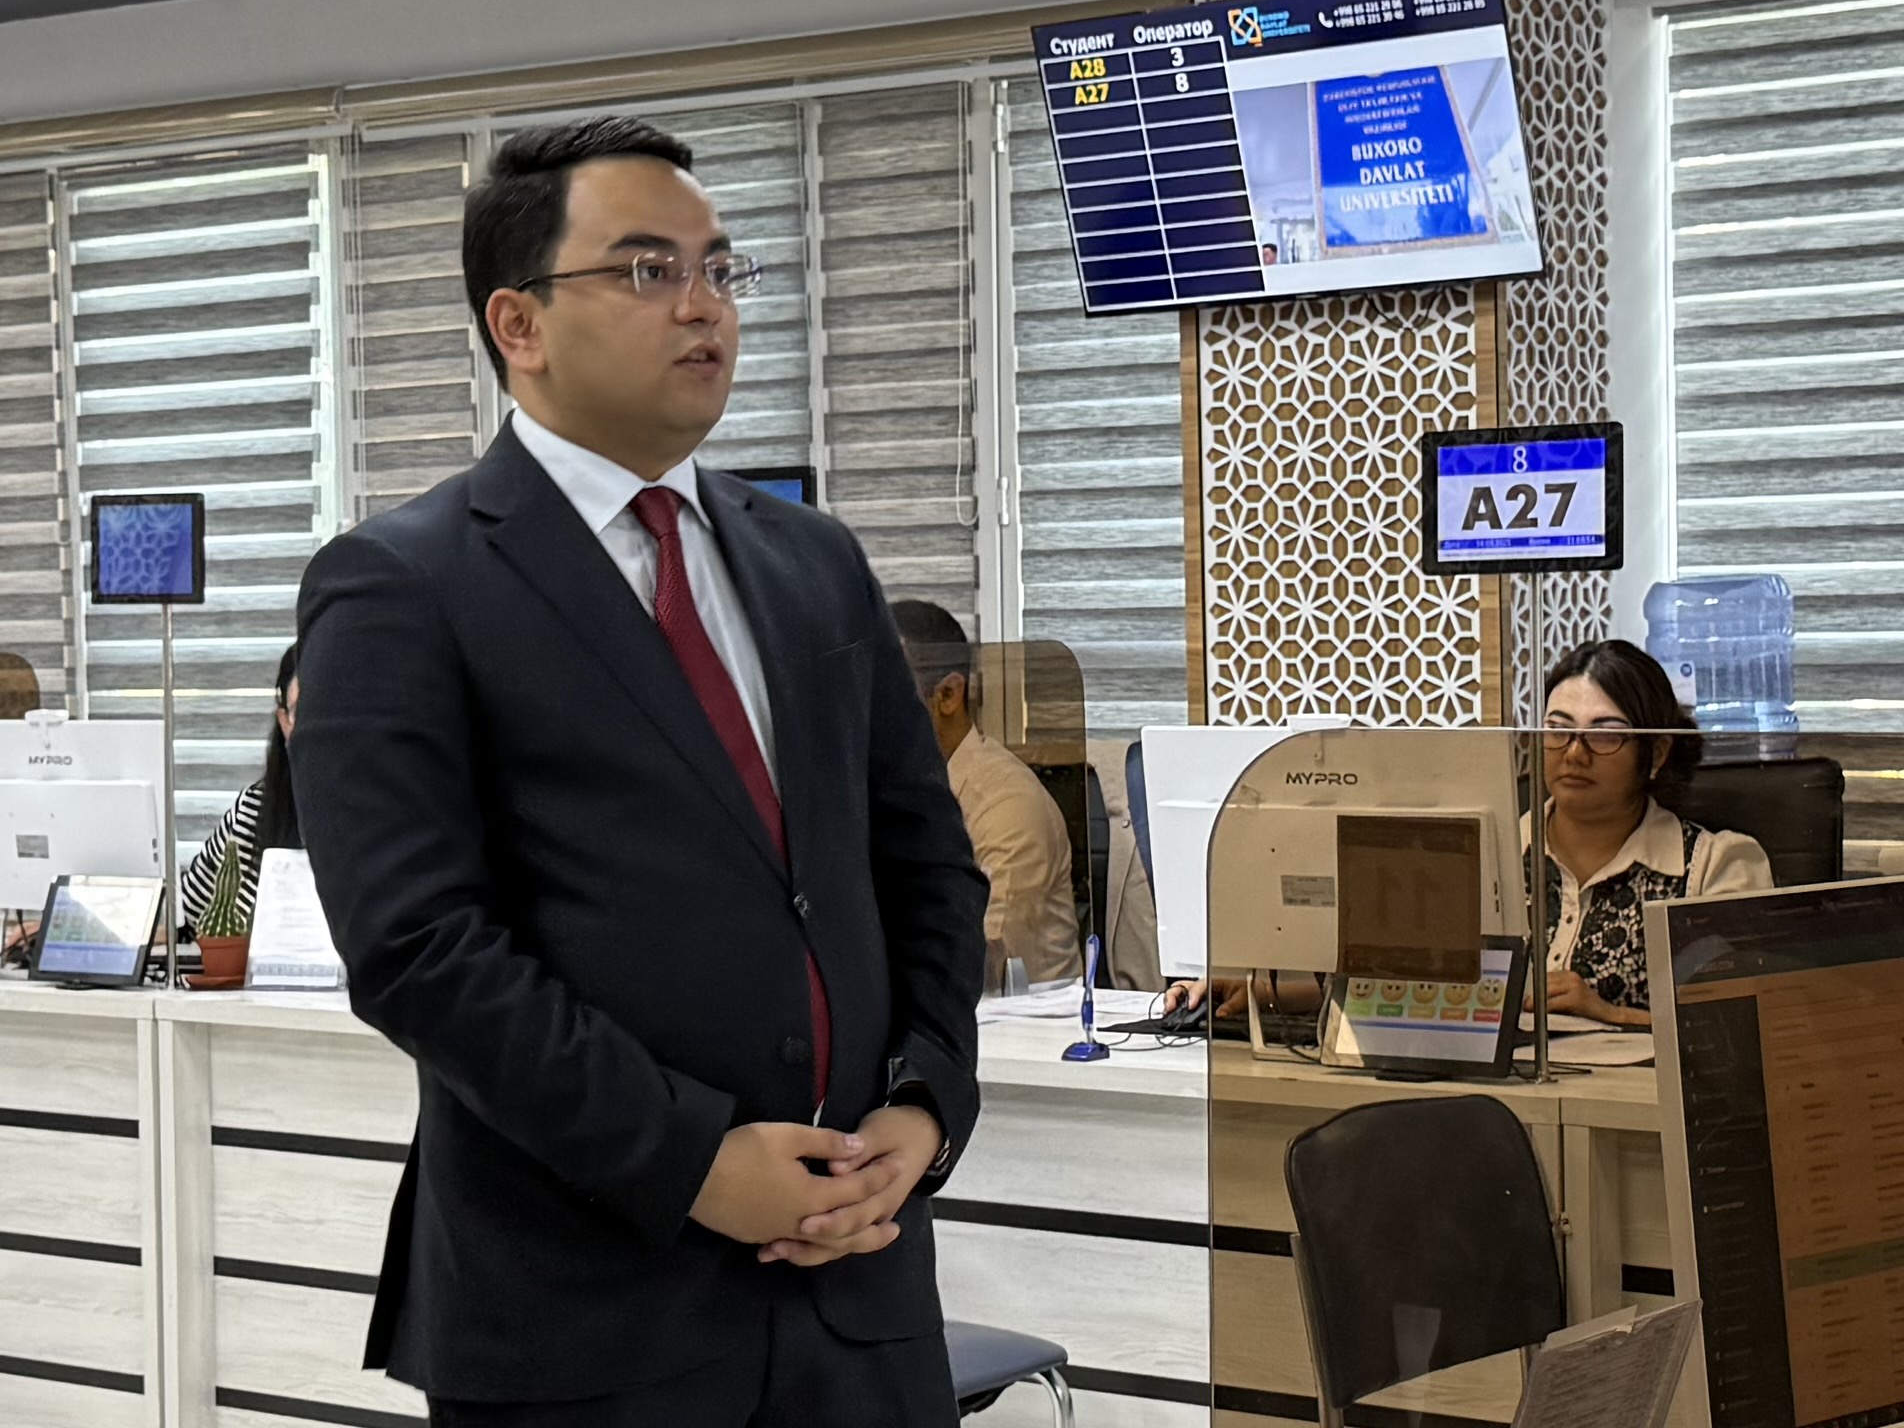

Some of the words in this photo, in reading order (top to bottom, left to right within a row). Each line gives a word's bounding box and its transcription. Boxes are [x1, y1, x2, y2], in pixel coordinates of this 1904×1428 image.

[1049, 33, 1115, 56] Студент
[1132, 19, 1214, 44] Оператор
[1170, 47, 1185, 67] 3
[1175, 73, 1189, 93] 8
[1351, 136, 1423, 162] BUXORO
[1359, 160, 1425, 186] DAVLAT
[1339, 183, 1455, 213] UNIVERSITETI
[1512, 445, 1528, 473] 8
[1461, 482, 1578, 531] A27
[1285, 771, 1358, 786] MYPRO
